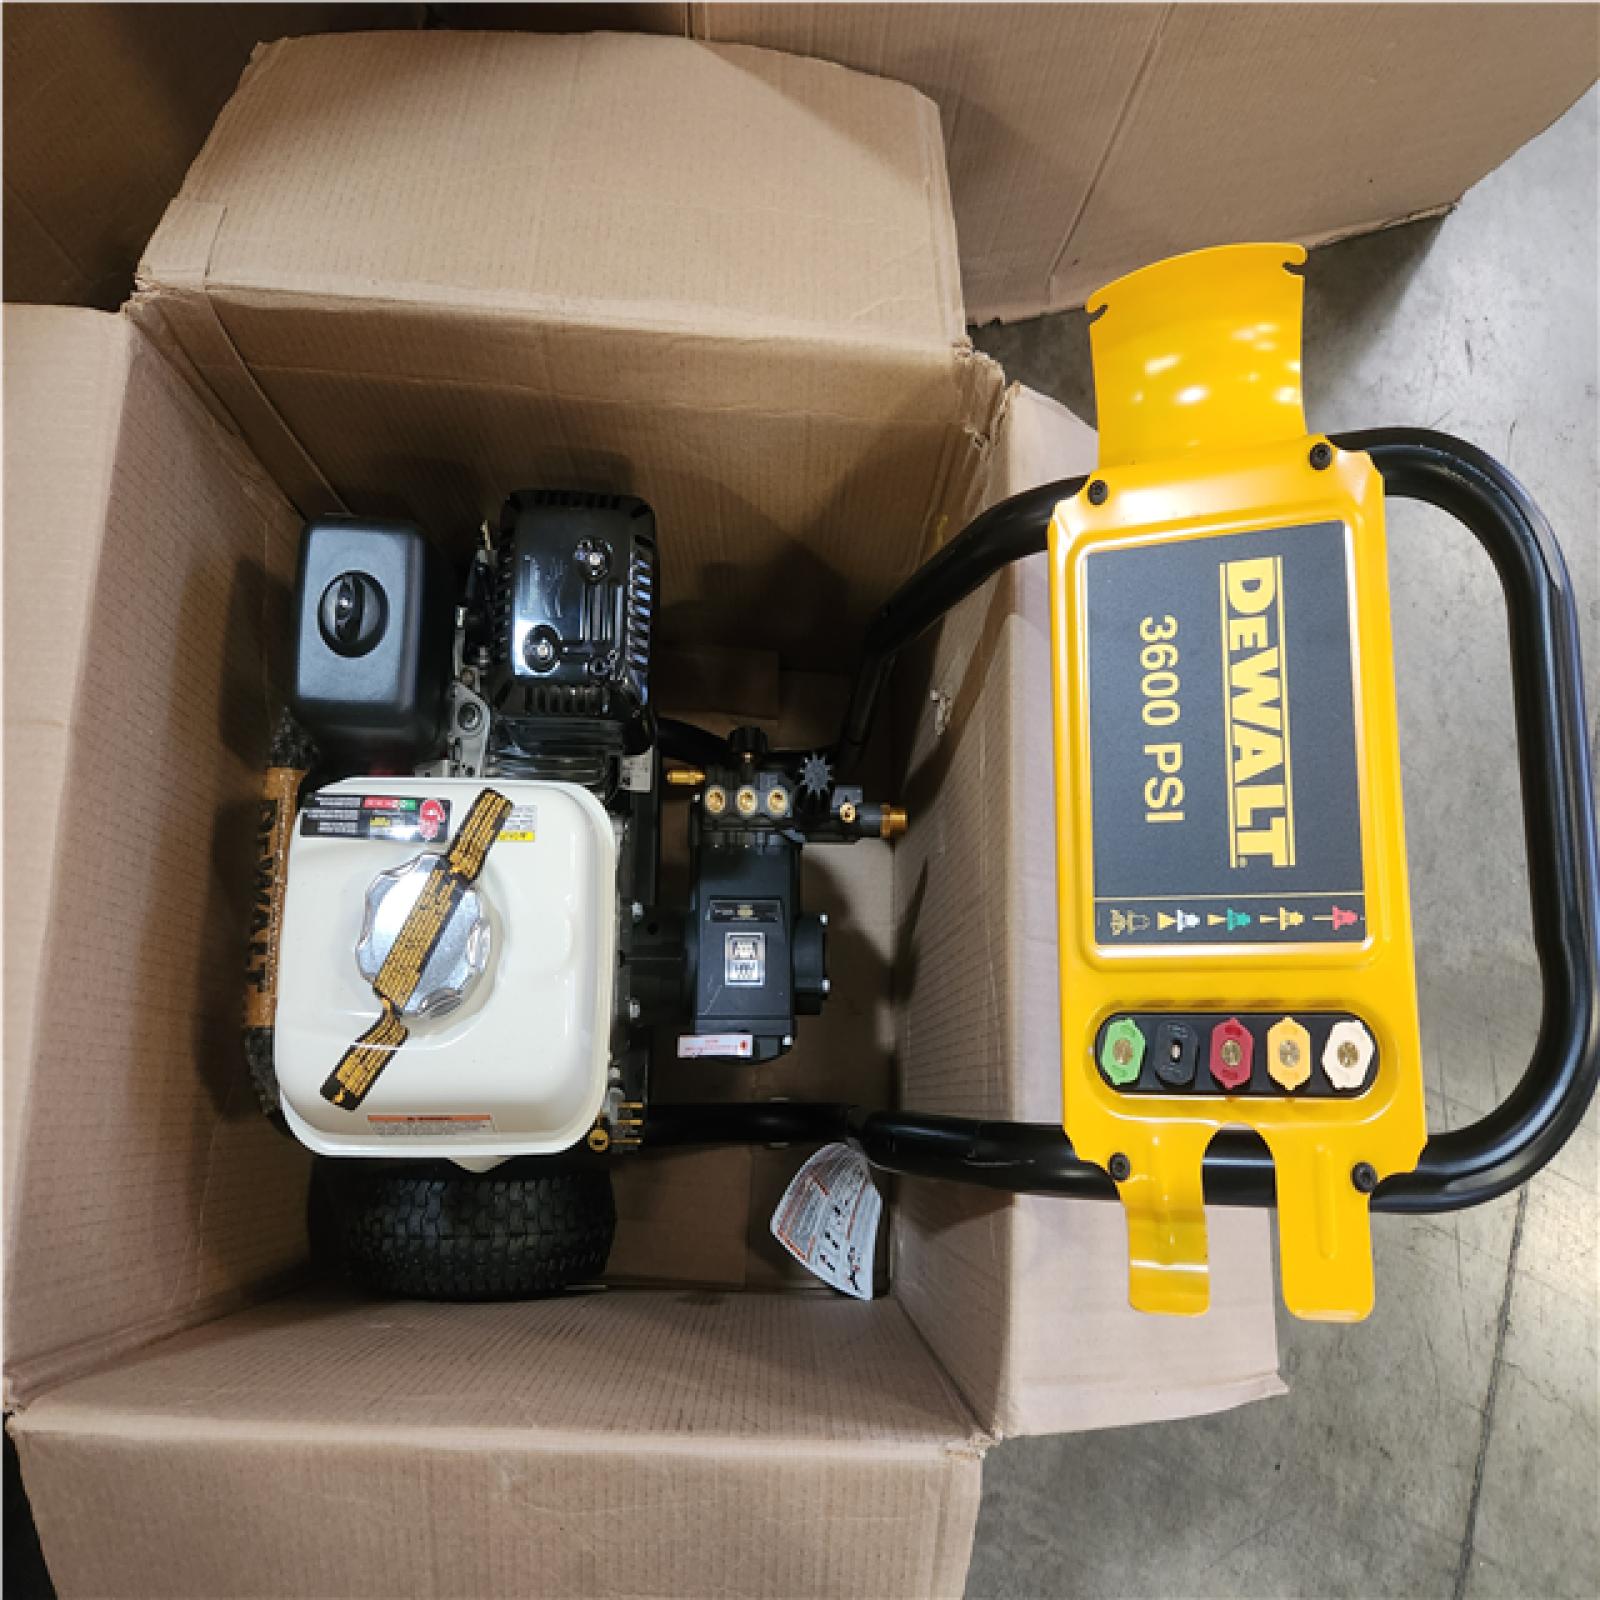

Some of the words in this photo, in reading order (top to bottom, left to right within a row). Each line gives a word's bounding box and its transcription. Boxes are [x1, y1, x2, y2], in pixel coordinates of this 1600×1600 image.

[1138, 614, 1182, 727] 3600
[1225, 556, 1288, 867] DEWALT
[1143, 742, 1185, 823] PSI
